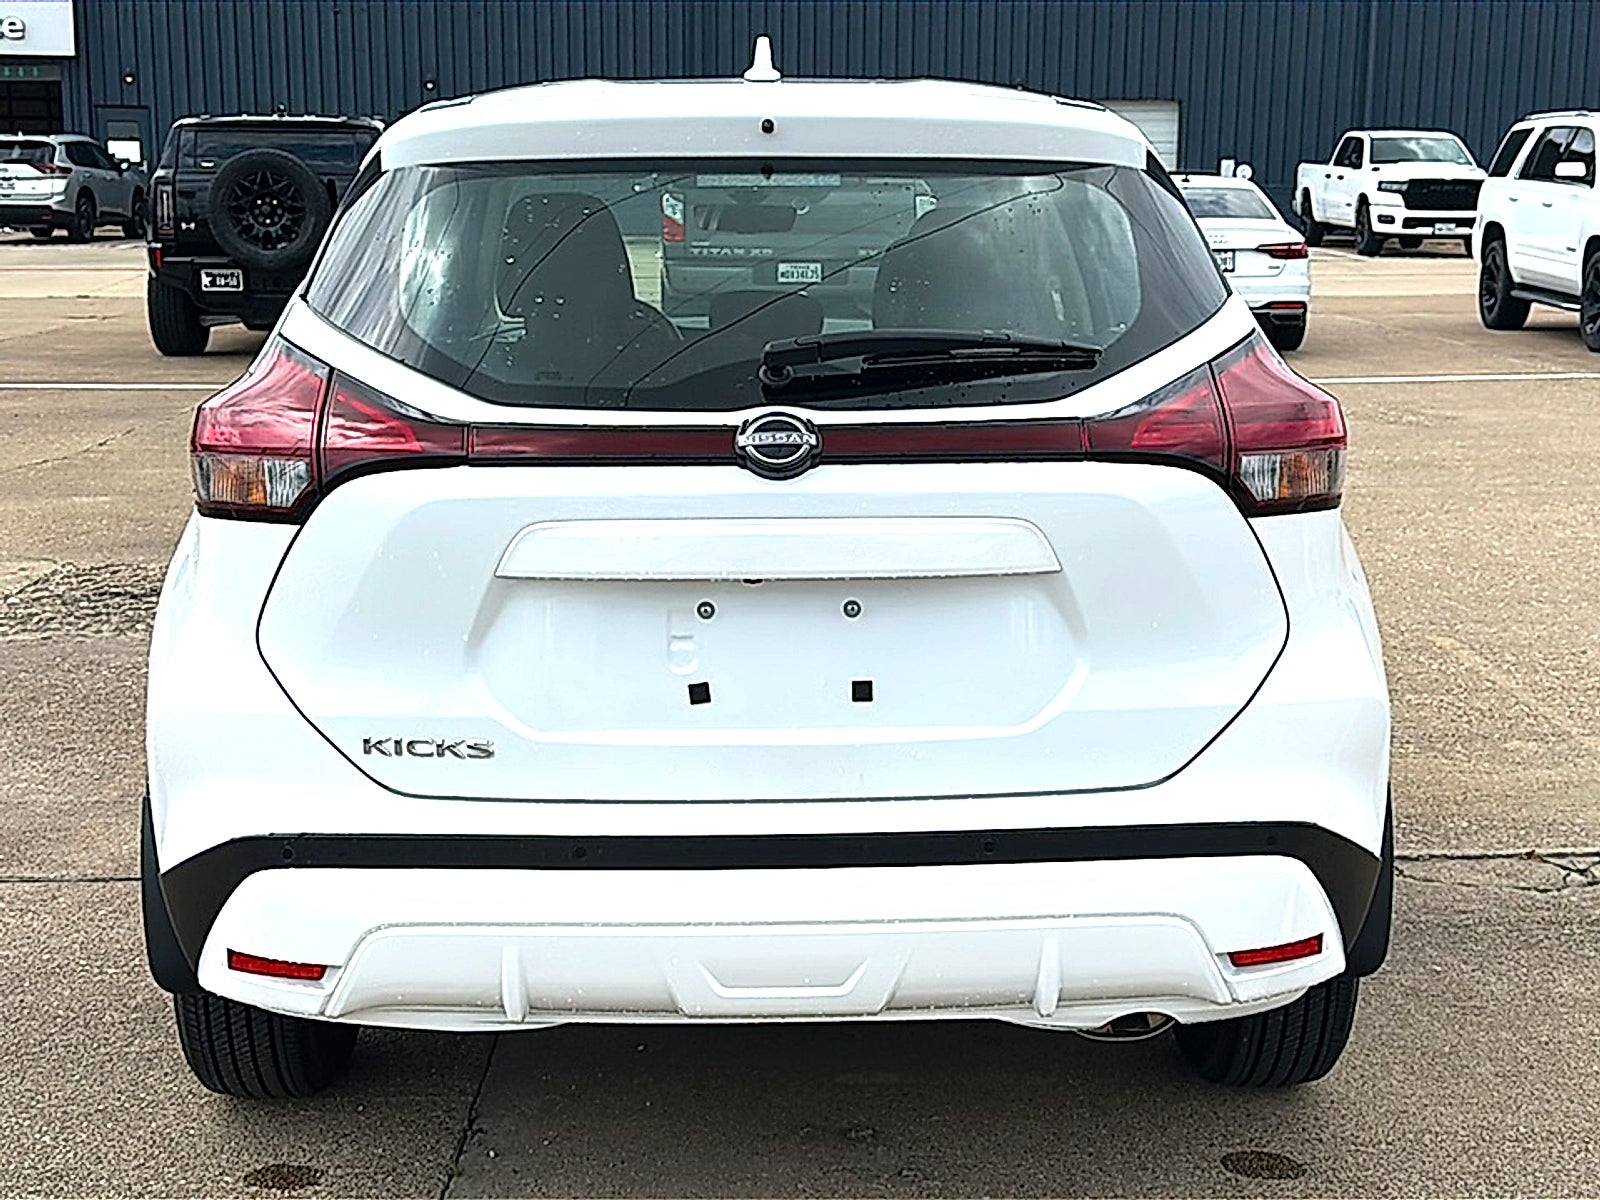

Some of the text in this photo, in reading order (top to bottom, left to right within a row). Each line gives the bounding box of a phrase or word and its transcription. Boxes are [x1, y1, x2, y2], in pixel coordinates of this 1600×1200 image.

[0, 16, 26, 40] e
[689, 247, 746, 256] TITAN
[740, 431, 817, 447] NISSAN
[362, 736, 495, 760] KICKS
